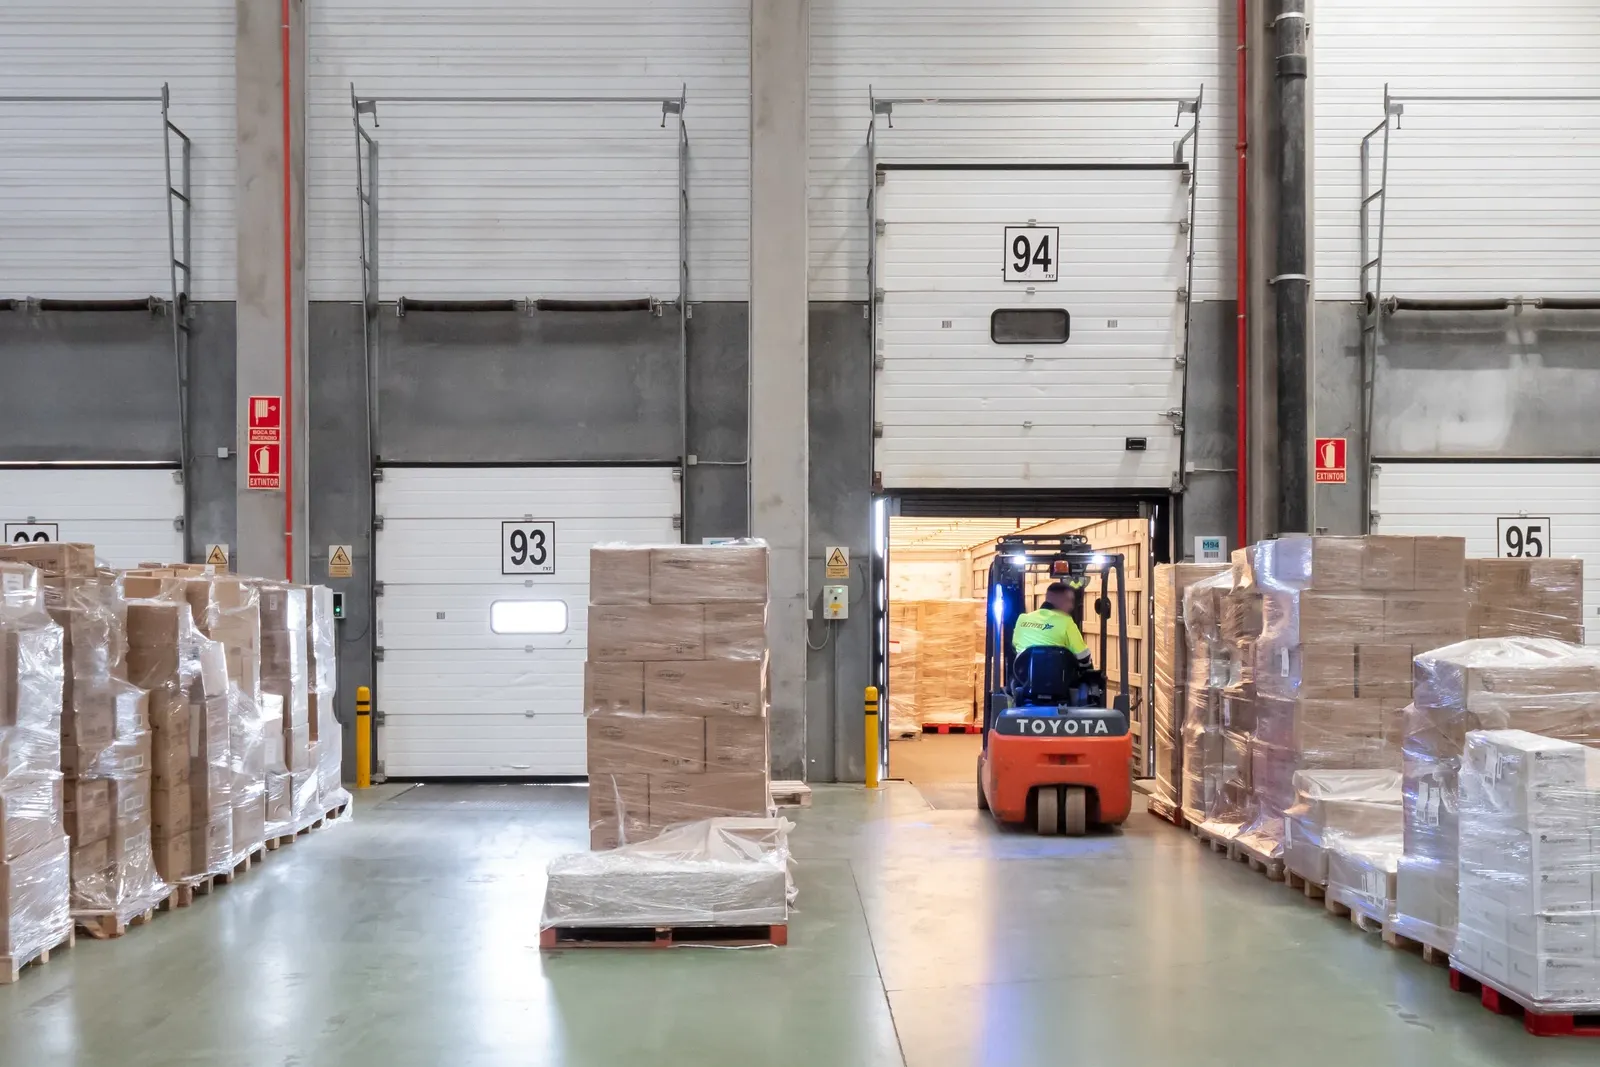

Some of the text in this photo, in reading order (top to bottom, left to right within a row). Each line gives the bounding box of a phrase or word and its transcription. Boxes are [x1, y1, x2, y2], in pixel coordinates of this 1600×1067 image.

[1012, 234, 1052, 273] 94
[249, 477, 279, 486] EXTINTOR
[1316, 472, 1344, 481] EXTINTOR
[510, 529, 547, 566] 93
[1202, 541, 1220, 549] M94
[1505, 525, 1543, 558] 95
[1016, 719, 1109, 734] TOYOTA
